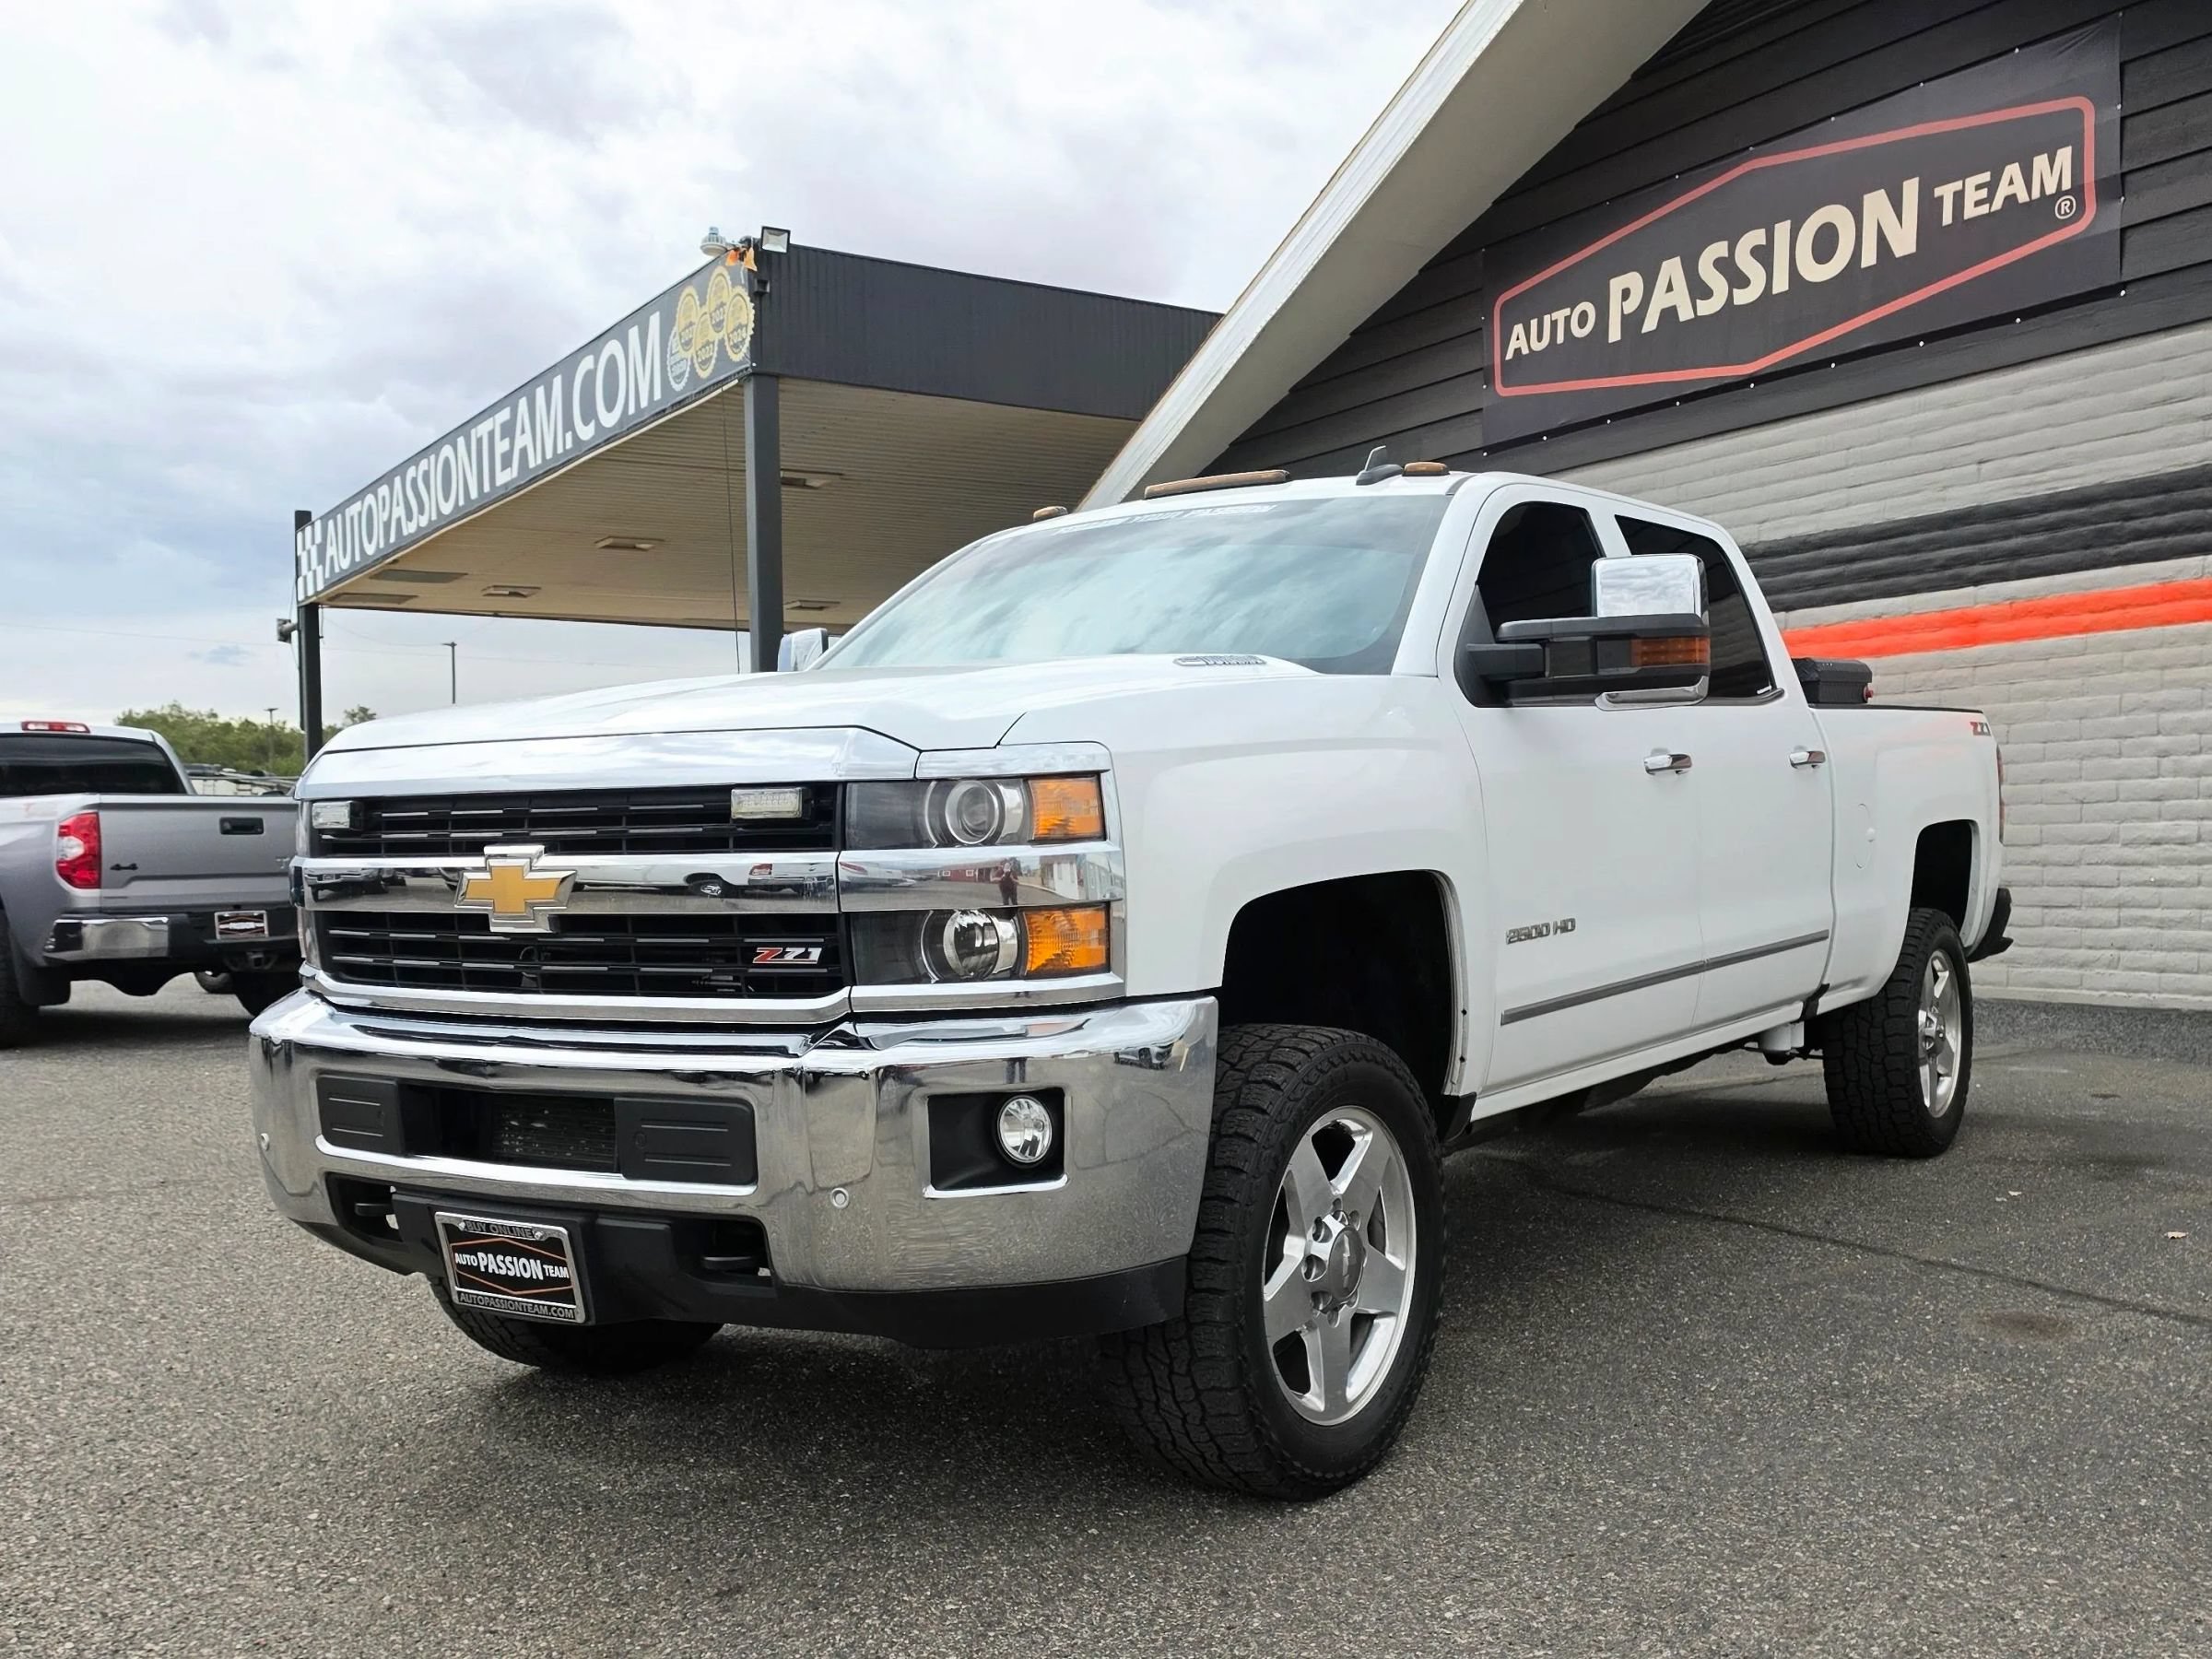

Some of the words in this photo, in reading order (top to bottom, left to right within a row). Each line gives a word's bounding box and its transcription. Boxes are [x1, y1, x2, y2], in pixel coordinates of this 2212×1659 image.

[1505, 300, 1596, 360] AUTO
[1607, 177, 1921, 344] PASSION
[1934, 146, 2073, 227] TEAM
[323, 311, 662, 579] AUTOPASSIONTEAM.COM
[1506, 923, 1551, 945] 2500
[1553, 918, 1577, 935] HD
[752, 947, 823, 964] Z71
[465, 1220, 488, 1232] BUY
[488, 1223, 534, 1239] ONLINE
[455, 1253, 478, 1266] AUTO
[477, 1252, 543, 1280] PASSION
[543, 1264, 570, 1278] TEAM
[459, 1293, 574, 1319] AUTOPASSIONTEAM.COM
